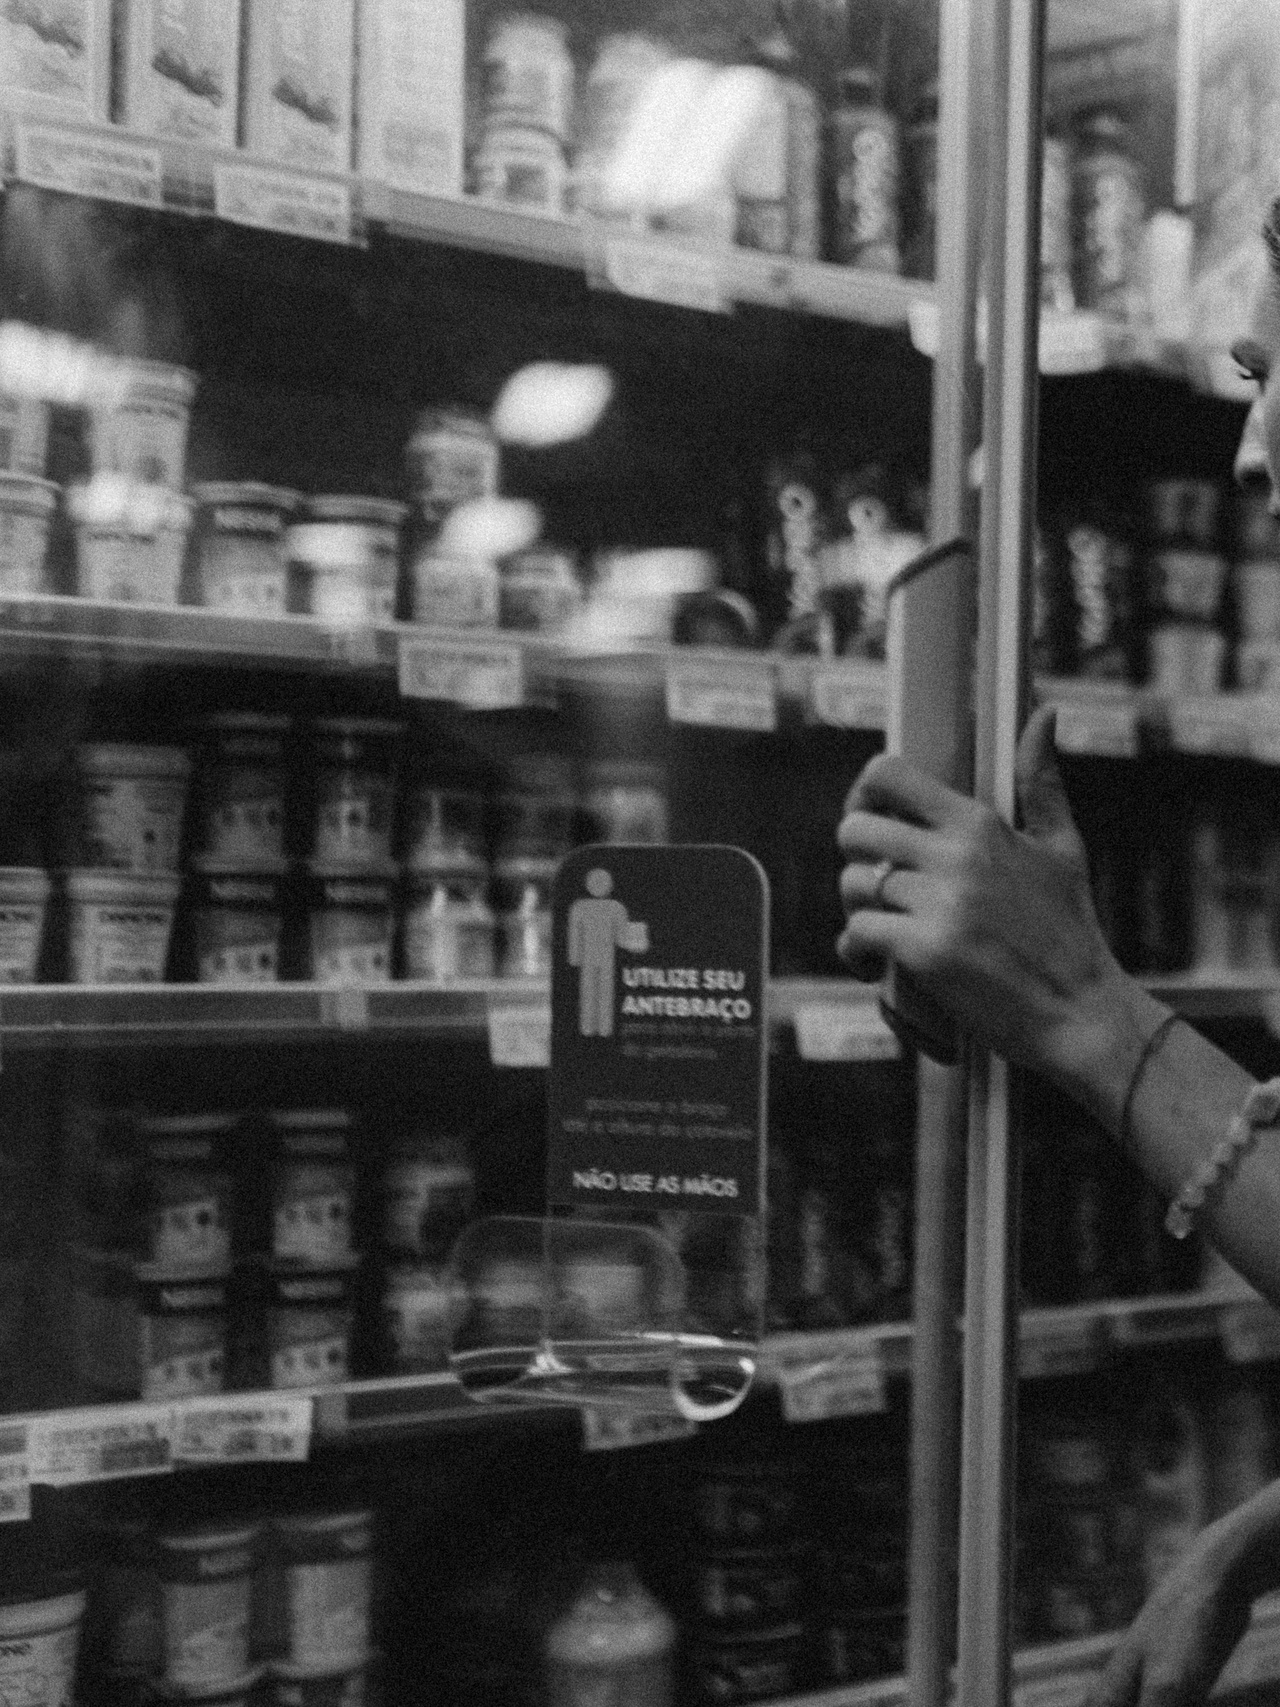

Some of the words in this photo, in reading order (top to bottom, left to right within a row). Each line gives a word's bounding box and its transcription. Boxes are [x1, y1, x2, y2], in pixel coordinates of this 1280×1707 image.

[622, 967, 699, 989] UTILIZE
[703, 969, 746, 992] SEU
[622, 996, 752, 1023] ANTEBRAÇO
[572, 1168, 617, 1191] NÃO
[619, 1174, 653, 1193] USE
[656, 1175, 680, 1195] AS
[683, 1174, 739, 1198] MÃOS
